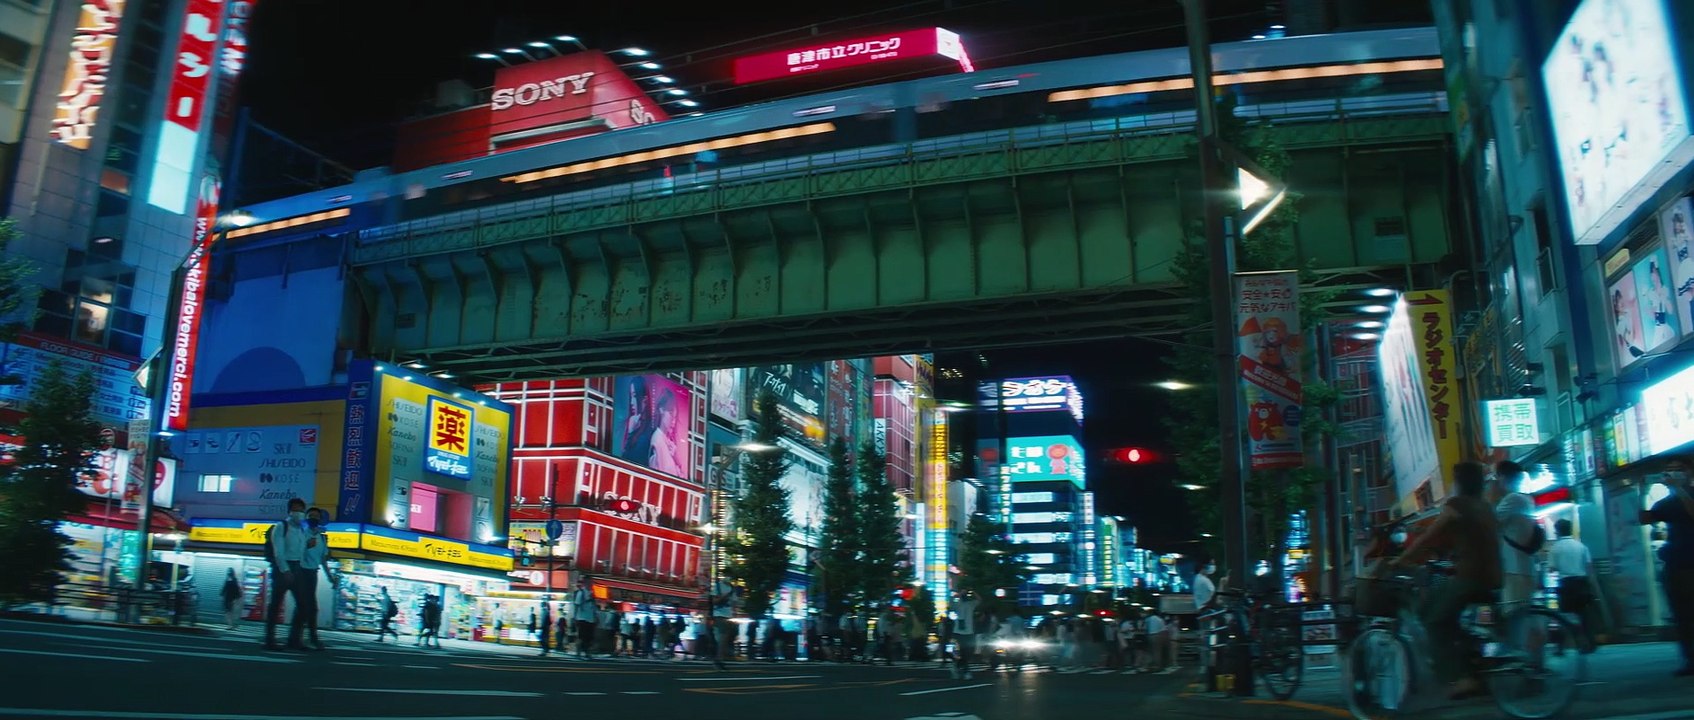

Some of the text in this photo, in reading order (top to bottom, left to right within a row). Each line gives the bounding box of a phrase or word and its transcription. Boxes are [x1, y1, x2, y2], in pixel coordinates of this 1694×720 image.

[177, 0, 219, 117] ルシー
[491, 72, 595, 111] SONY
[1422, 311, 1450, 440] ラジオセンター
[435, 405, 468, 453] 薬
[1493, 402, 1532, 422] 携帯
[1497, 423, 1534, 443] 買取
